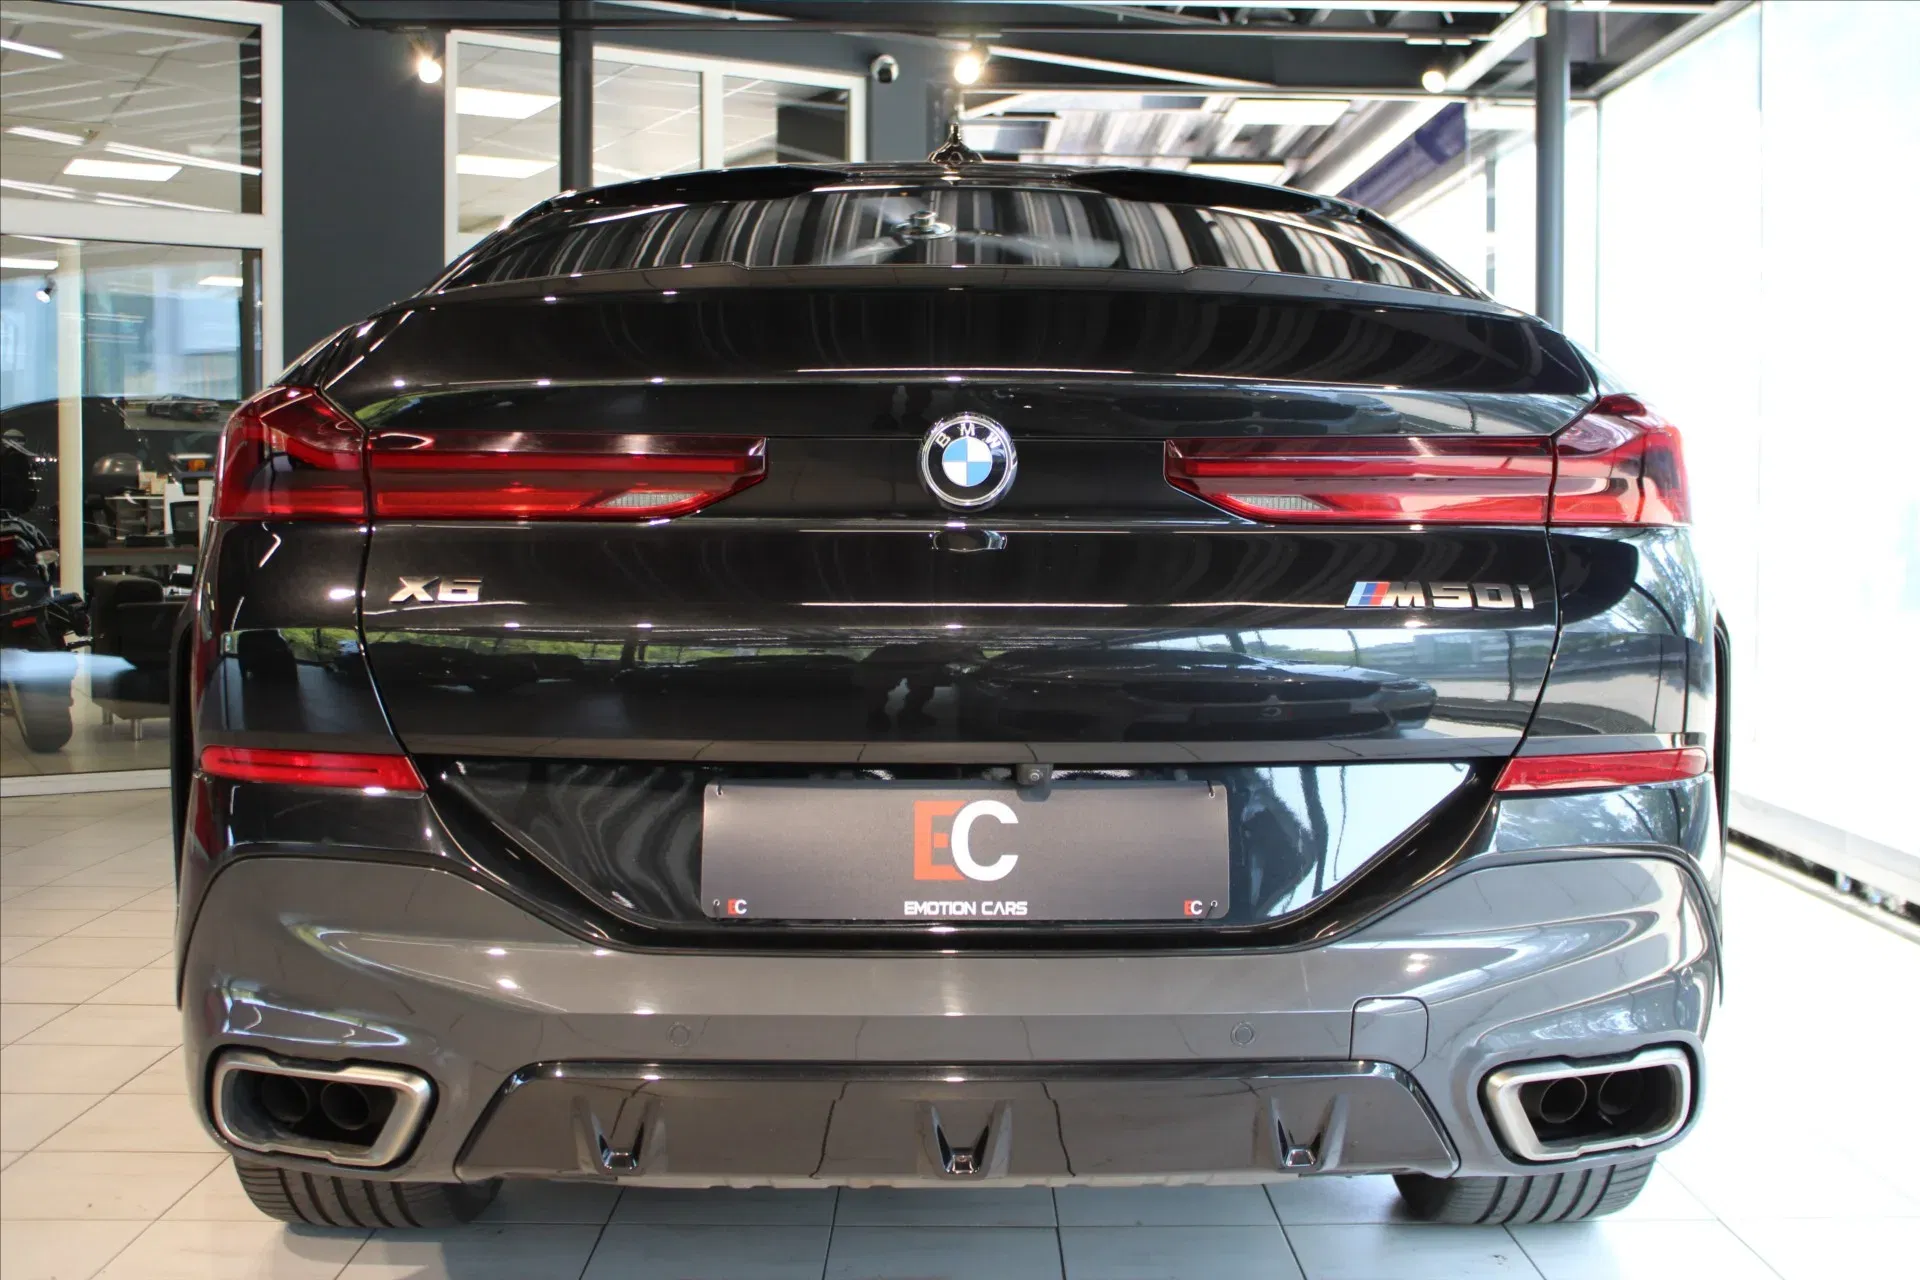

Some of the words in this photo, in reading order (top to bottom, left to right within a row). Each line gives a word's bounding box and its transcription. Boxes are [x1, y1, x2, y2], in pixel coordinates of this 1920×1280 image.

[935, 422, 1002, 449] BMW
[388, 576, 483, 603] X6
[1382, 580, 1535, 610] M50i
[914, 799, 1019, 882] EC
[727, 899, 748, 916] EC
[903, 900, 977, 916] EMOTION
[980, 900, 1028, 916] CARS
[1183, 899, 1203, 916] EC
